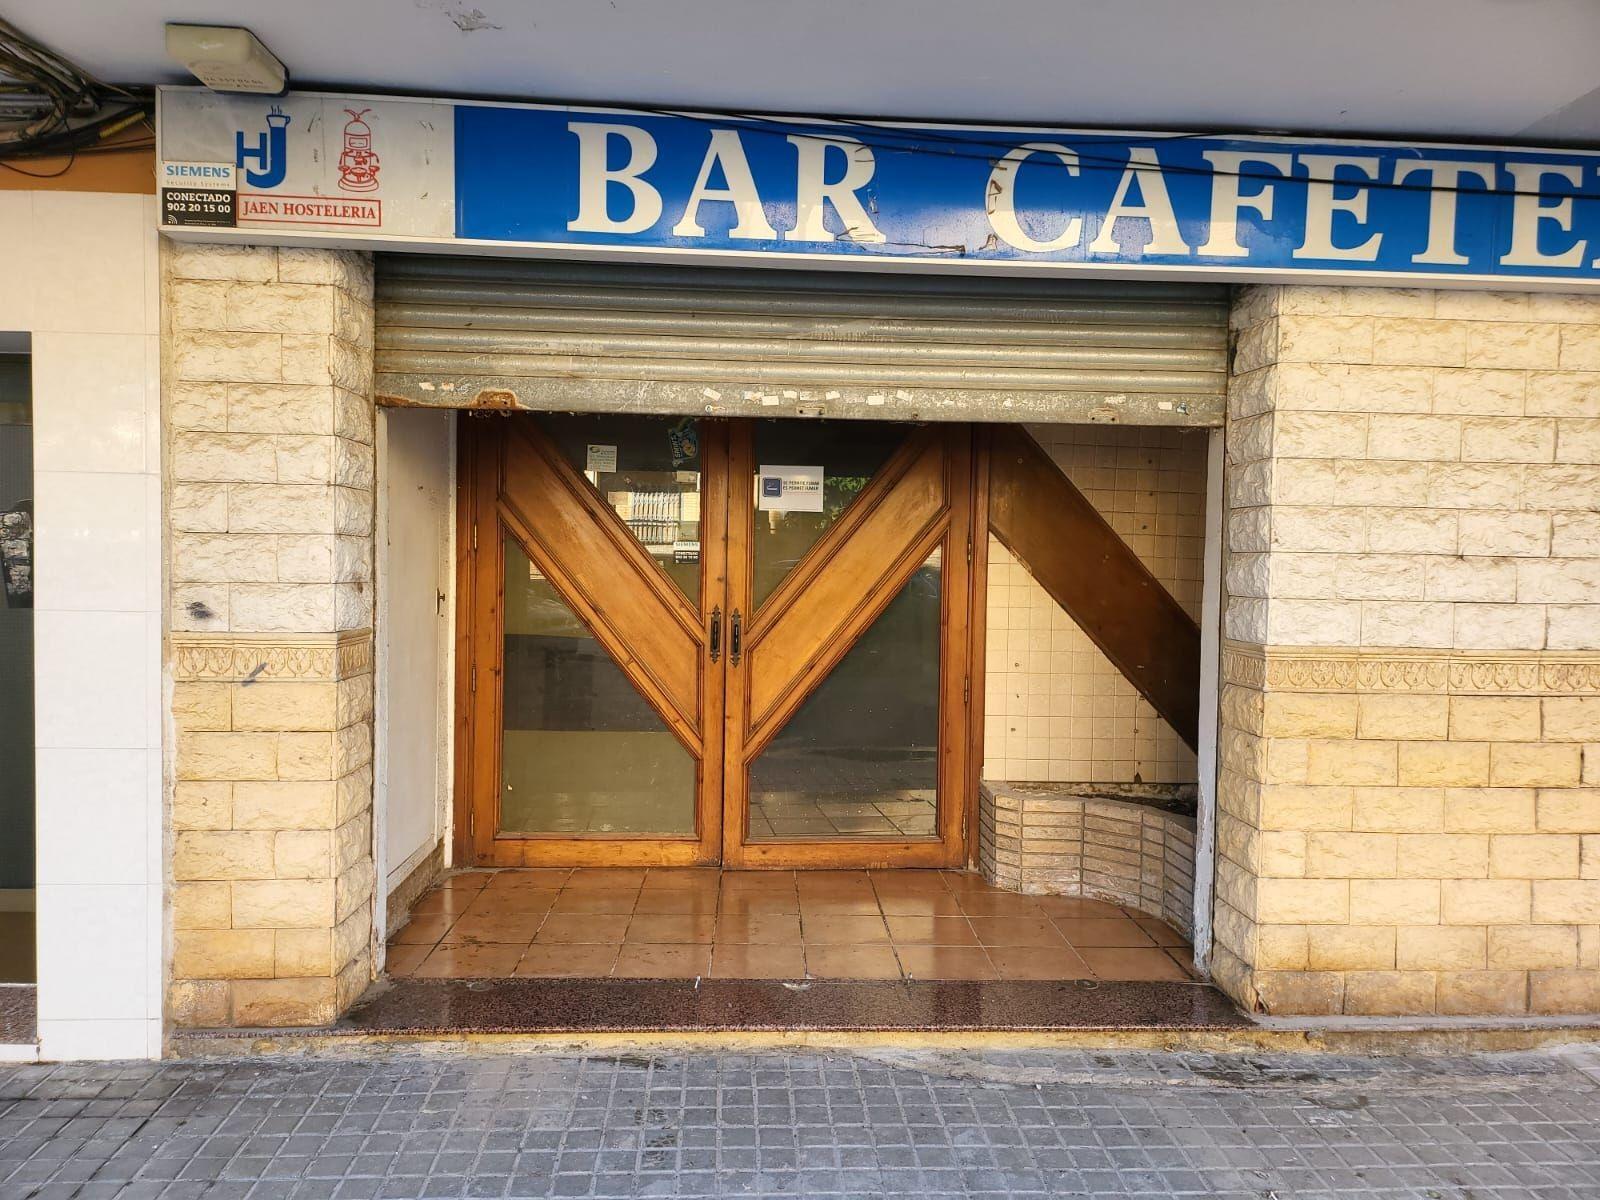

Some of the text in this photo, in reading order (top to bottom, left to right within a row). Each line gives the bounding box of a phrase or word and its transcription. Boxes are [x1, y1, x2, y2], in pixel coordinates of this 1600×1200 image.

[166, 165, 231, 178] SIEMENS
[166, 192, 231, 203] CONECTADO
[567, 121, 1600, 269] BAR CAFETE
[167, 202, 231, 214] 902 20 15 00
[243, 200, 377, 220] JAEN HOSTELERIA
